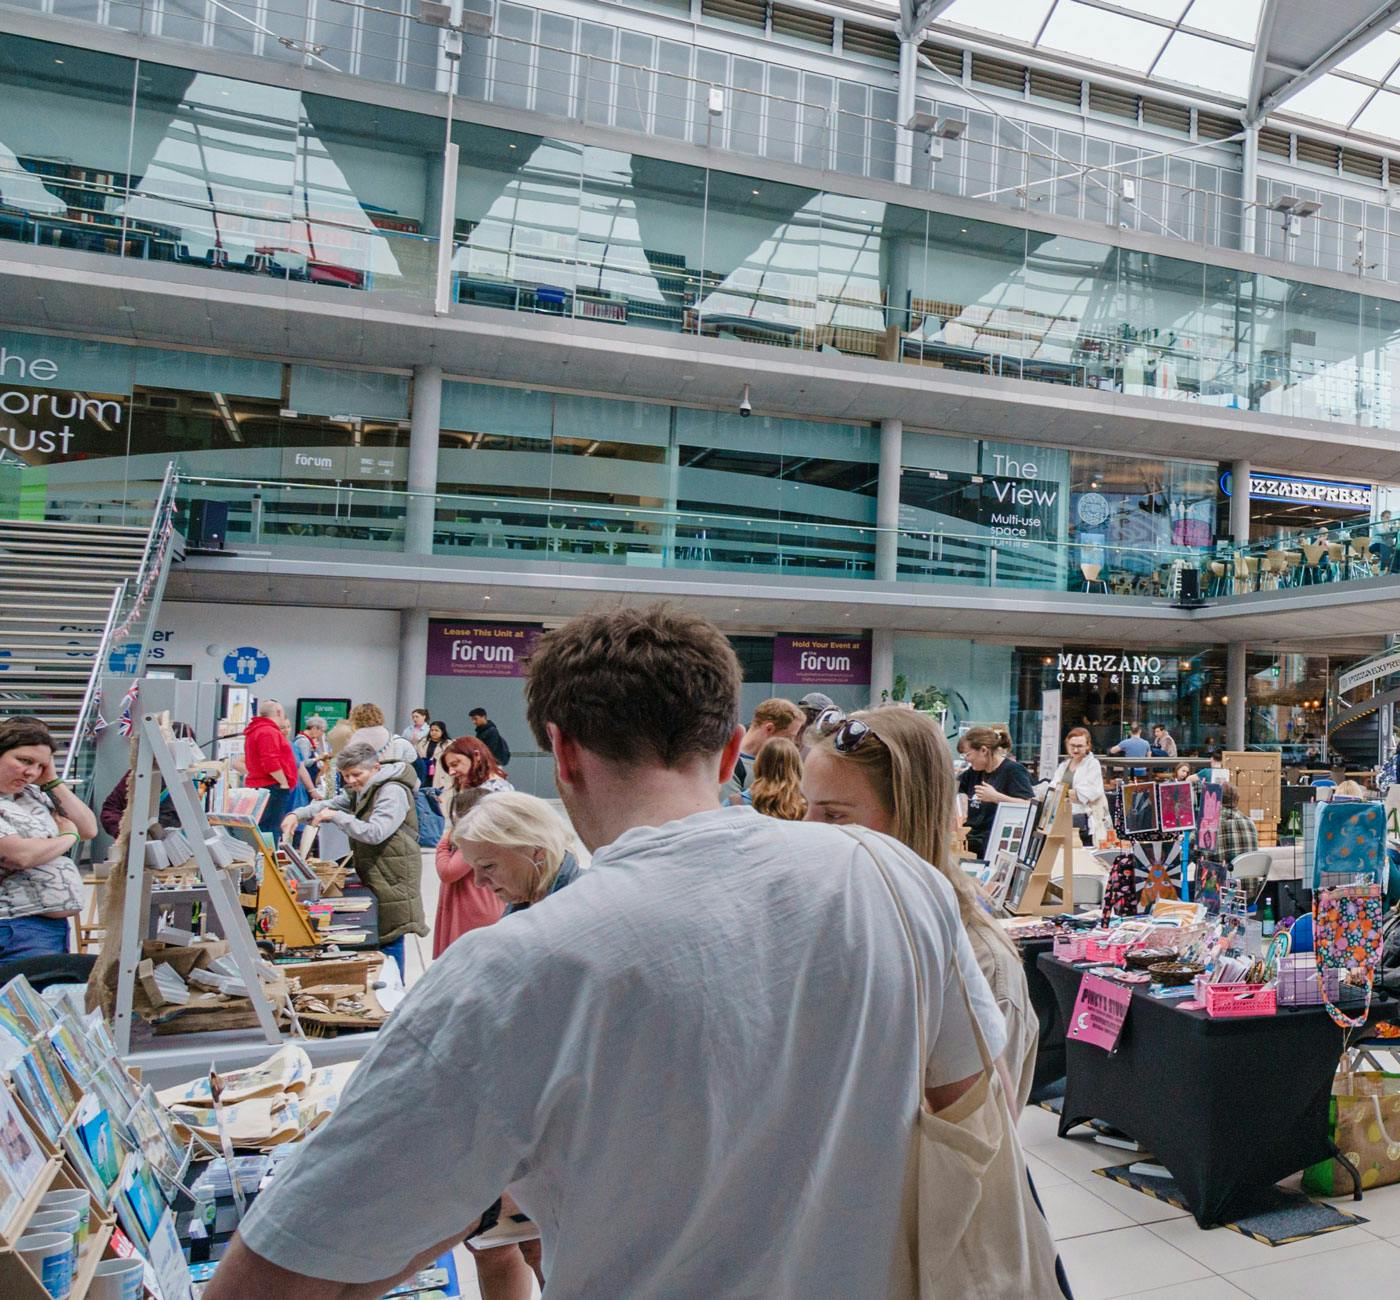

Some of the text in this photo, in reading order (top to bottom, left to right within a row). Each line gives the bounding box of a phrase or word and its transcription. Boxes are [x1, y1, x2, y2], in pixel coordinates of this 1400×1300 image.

[0, 347, 58, 380] he
[0, 391, 121, 424] orum
[0, 426, 75, 454] ust
[295, 453, 332, 468] forum
[992, 454, 1038, 479] The
[992, 480, 1056, 507] View
[1249, 478, 1371, 505] IZZAEXPRESS
[991, 513, 1041, 527] Multi-use
[991, 526, 1026, 537] space
[444, 628, 471, 636] Lease
[473, 629, 492, 637] This
[494, 629, 513, 637] Unit
[452, 640, 514, 662] forum
[800, 651, 850, 671] forum
[1057, 653, 1161, 673] MARZANO
[1056, 673, 1161, 685] CAFE & BAR
